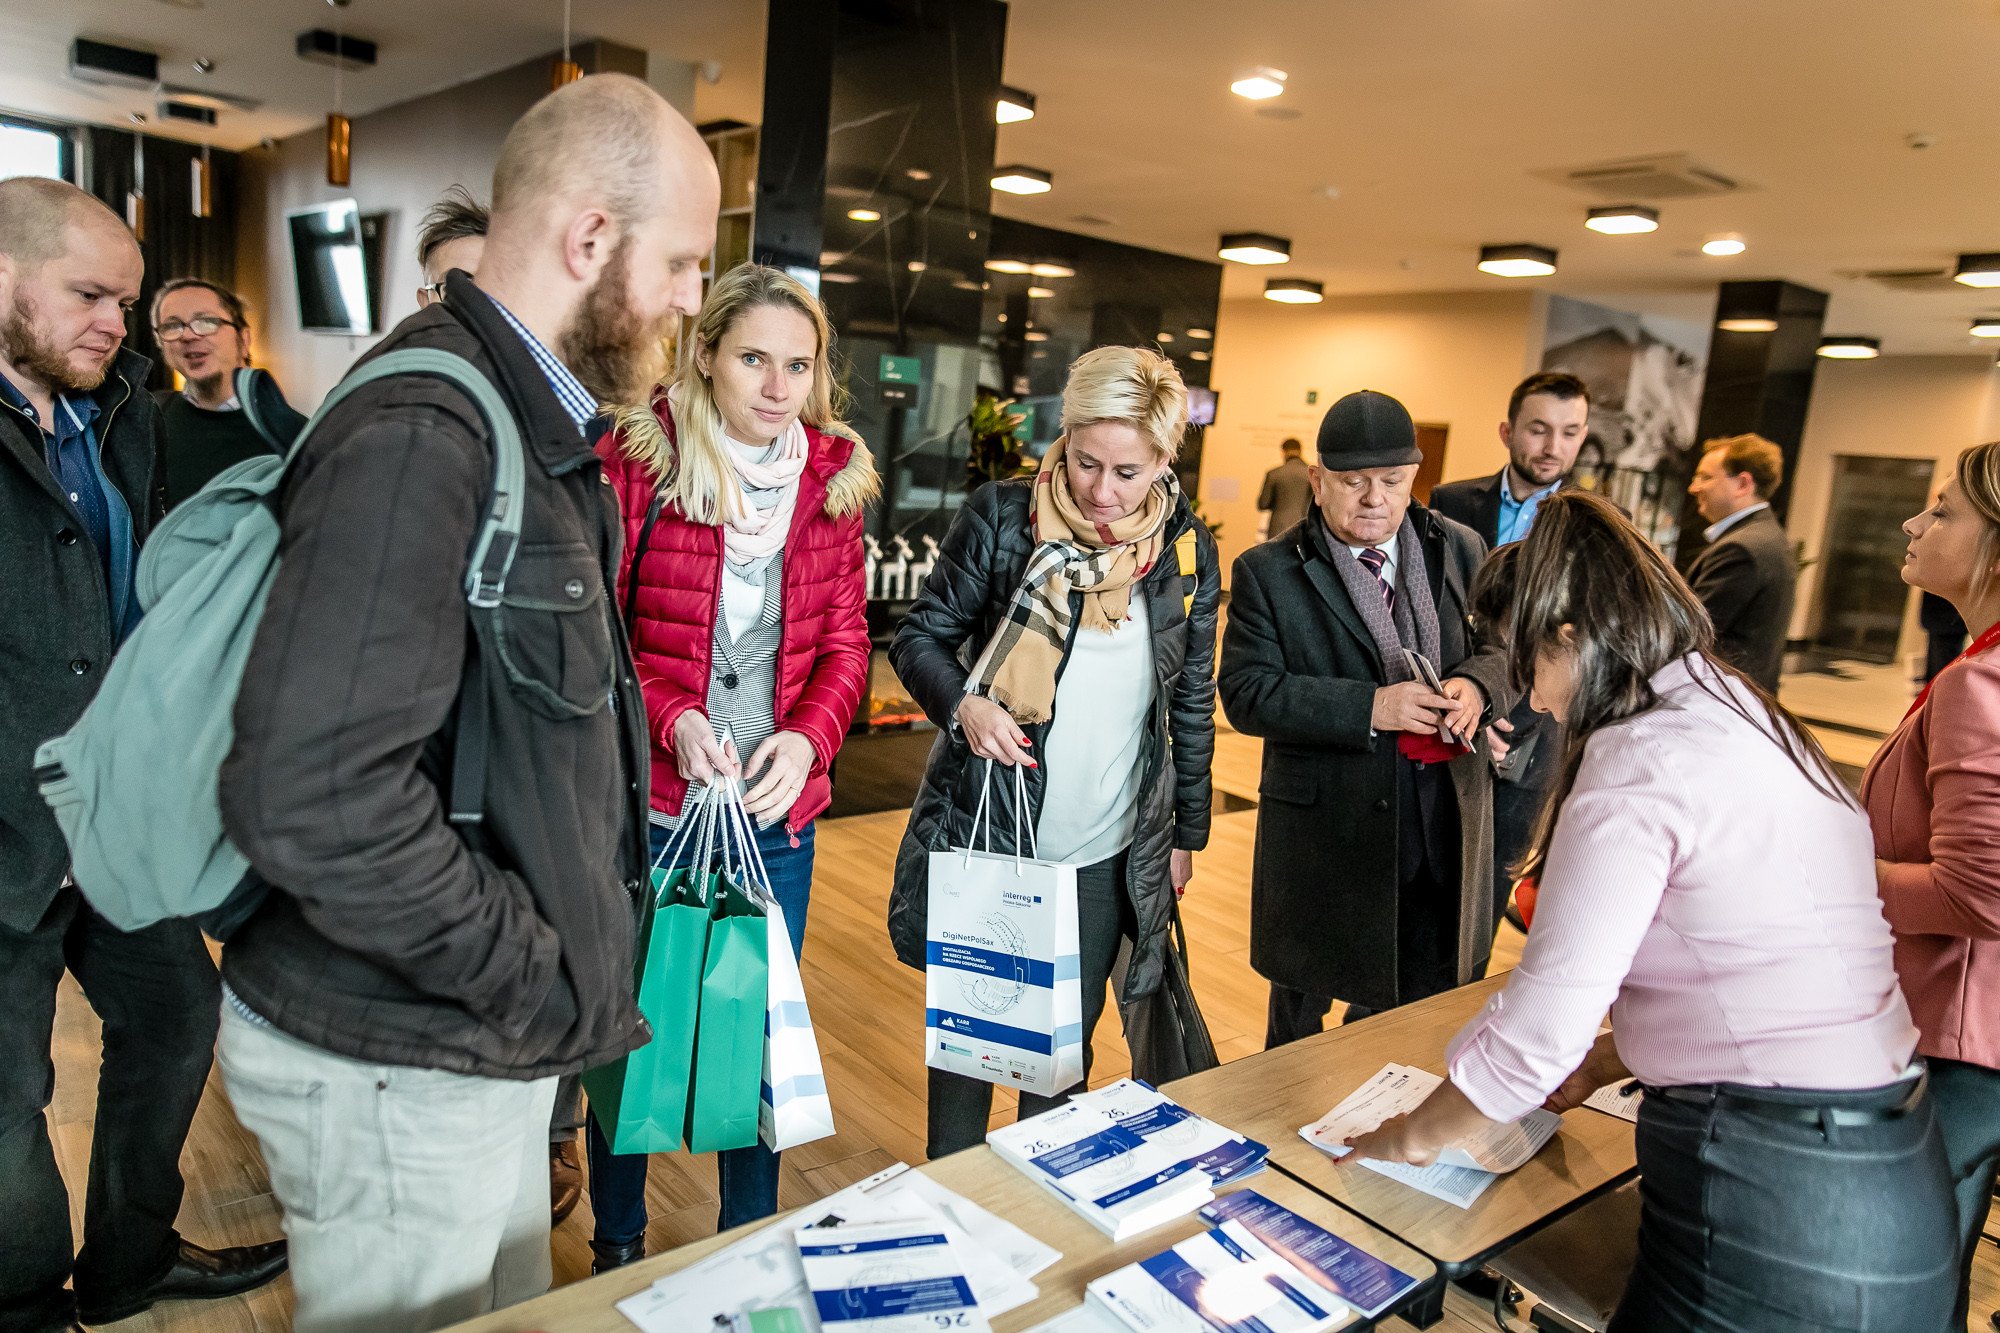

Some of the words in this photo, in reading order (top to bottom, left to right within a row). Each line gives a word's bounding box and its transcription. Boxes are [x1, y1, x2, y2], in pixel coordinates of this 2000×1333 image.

[942, 931, 994, 946] DigiNetPolSax
[956, 1018, 970, 1027] KARR
[1101, 1108, 1130, 1119] 26.
[1024, 1140, 1058, 1154] 26.
